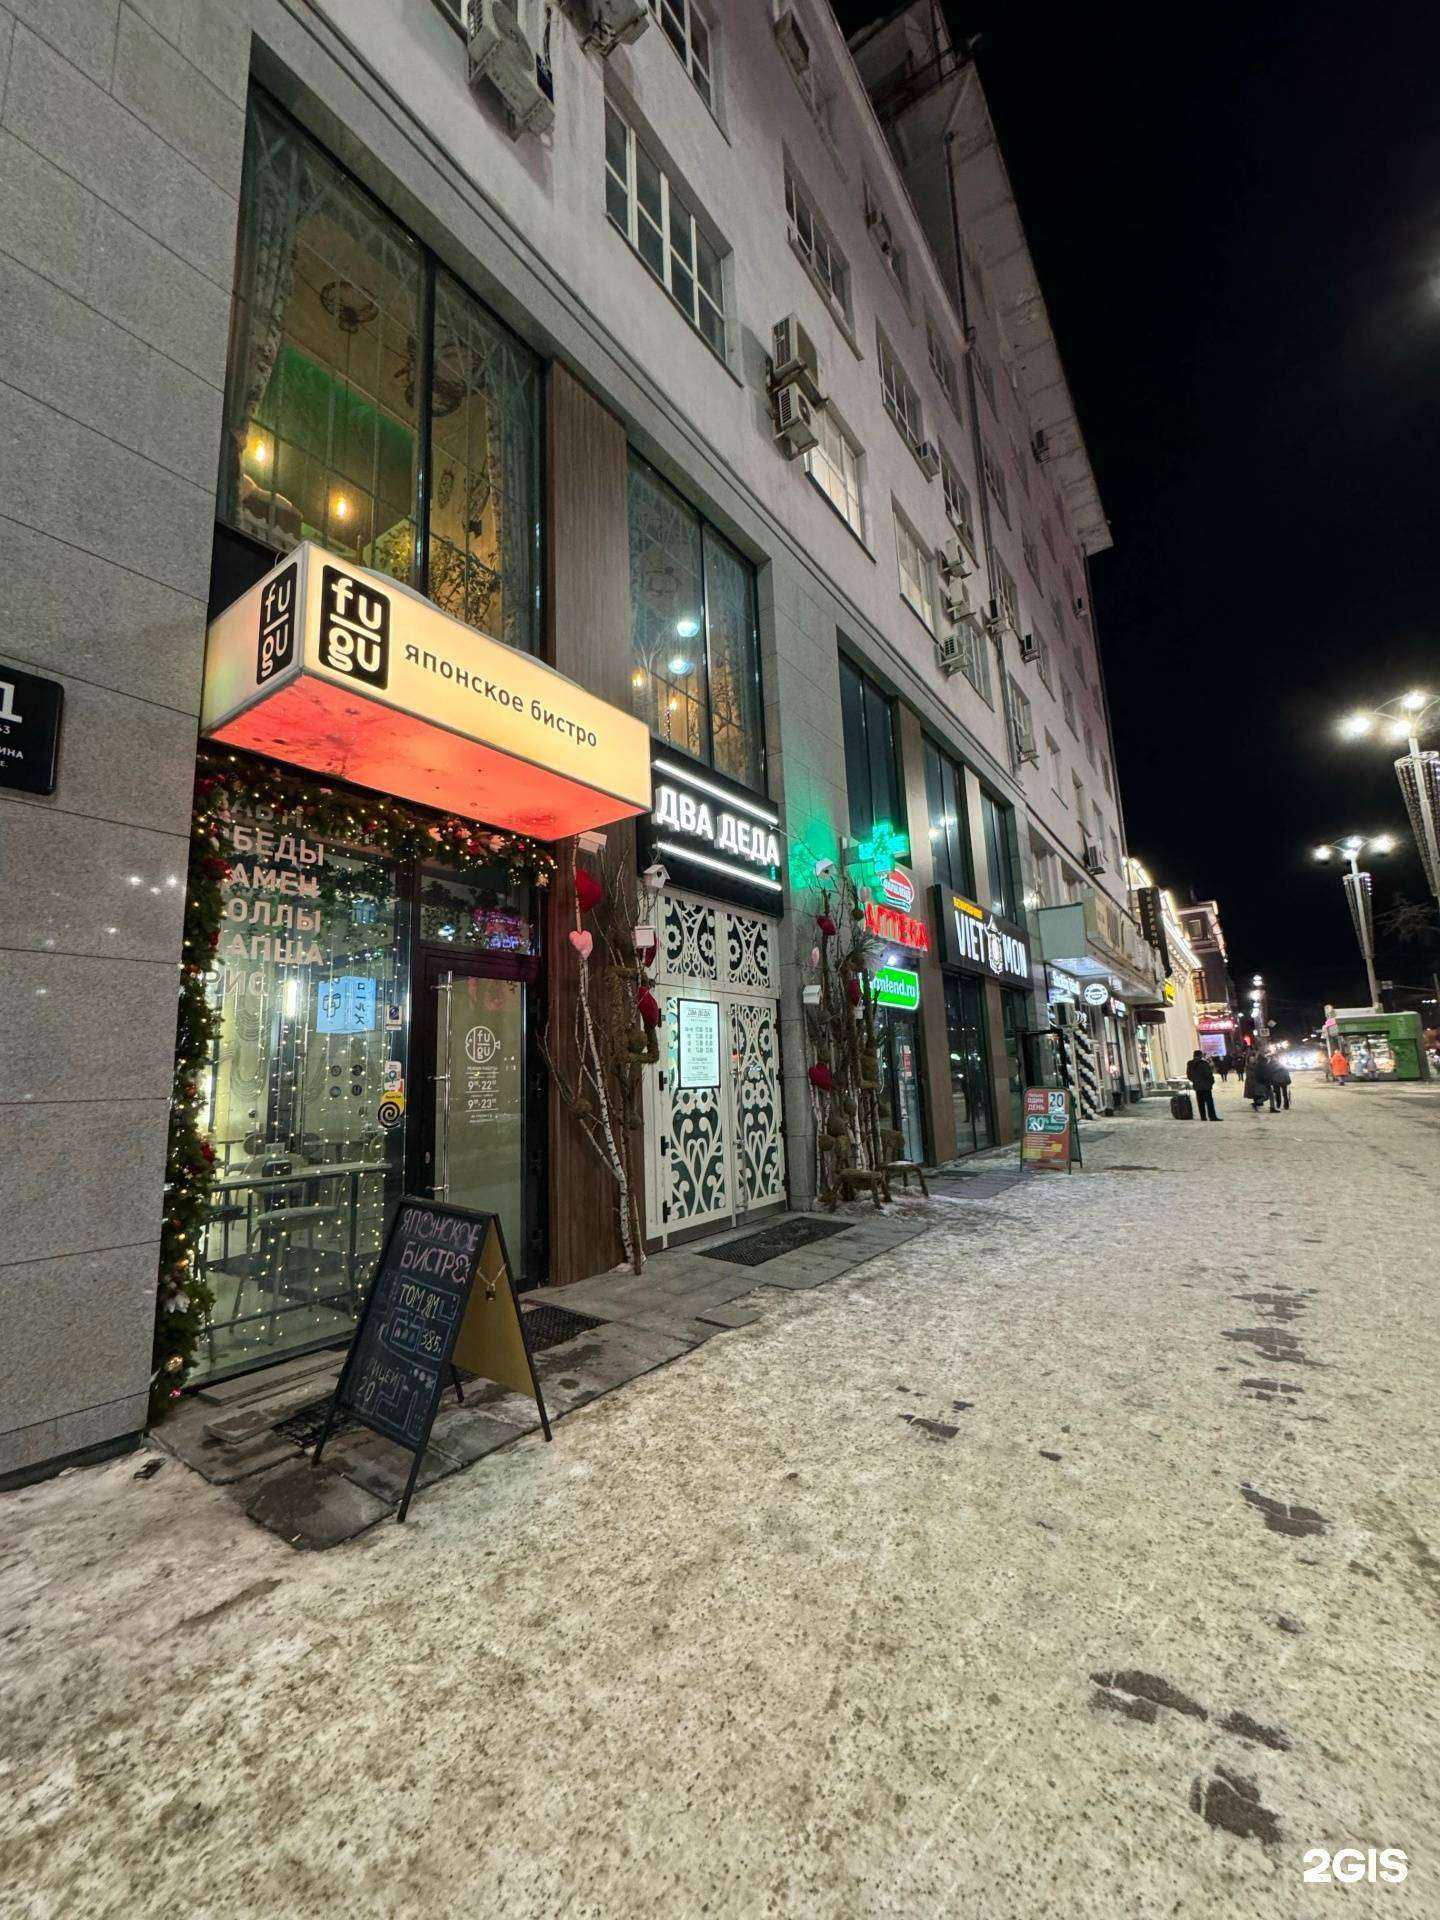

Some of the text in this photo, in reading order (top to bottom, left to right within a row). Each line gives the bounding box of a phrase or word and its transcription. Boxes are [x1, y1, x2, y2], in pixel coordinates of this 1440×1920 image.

[266, 580, 290, 622] fu
[331, 578, 382, 630] fu
[262, 624, 288, 677] gu
[327, 627, 381, 672] gu
[405, 644, 598, 748] японское бистро
[222, 825, 324, 867] БЕДЫ
[652, 785, 780, 867] ДВА ДЕДА
[230, 862, 320, 898] АМЕН
[227, 897, 322, 934] ОЛЛЫ
[954, 910, 986, 963] VIET
[400, 1208, 483, 1252] ЯПОНСКОЕ
[401, 1241, 472, 1285] БИСТРО
